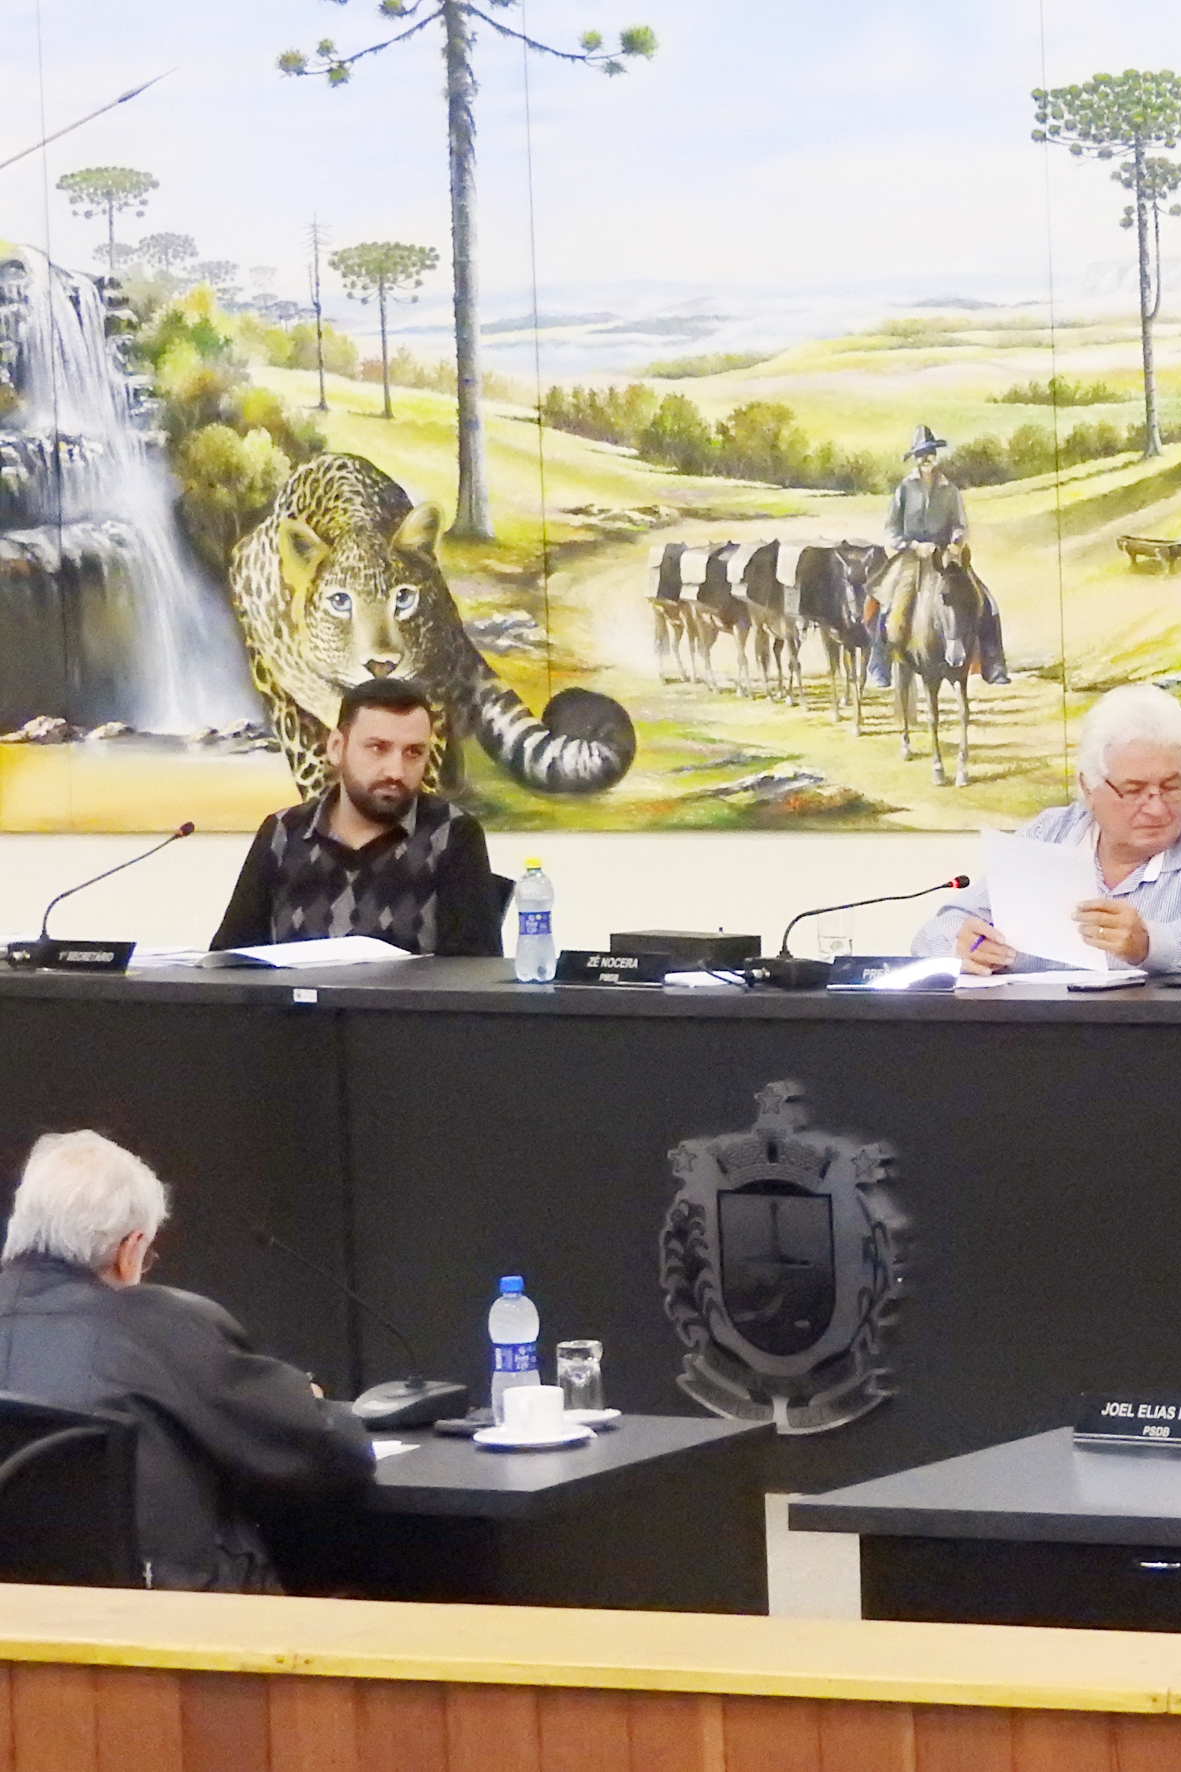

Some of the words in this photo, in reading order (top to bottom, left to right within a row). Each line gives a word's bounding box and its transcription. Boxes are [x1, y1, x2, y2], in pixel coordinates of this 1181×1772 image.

[586, 954, 600, 968] ZÉ
[600, 956, 639, 969] NOCERA
[1100, 1401, 1135, 1418] JOEL
[1137, 1403, 1176, 1420] ELIAS
[1142, 1424, 1171, 1438] PSDB
